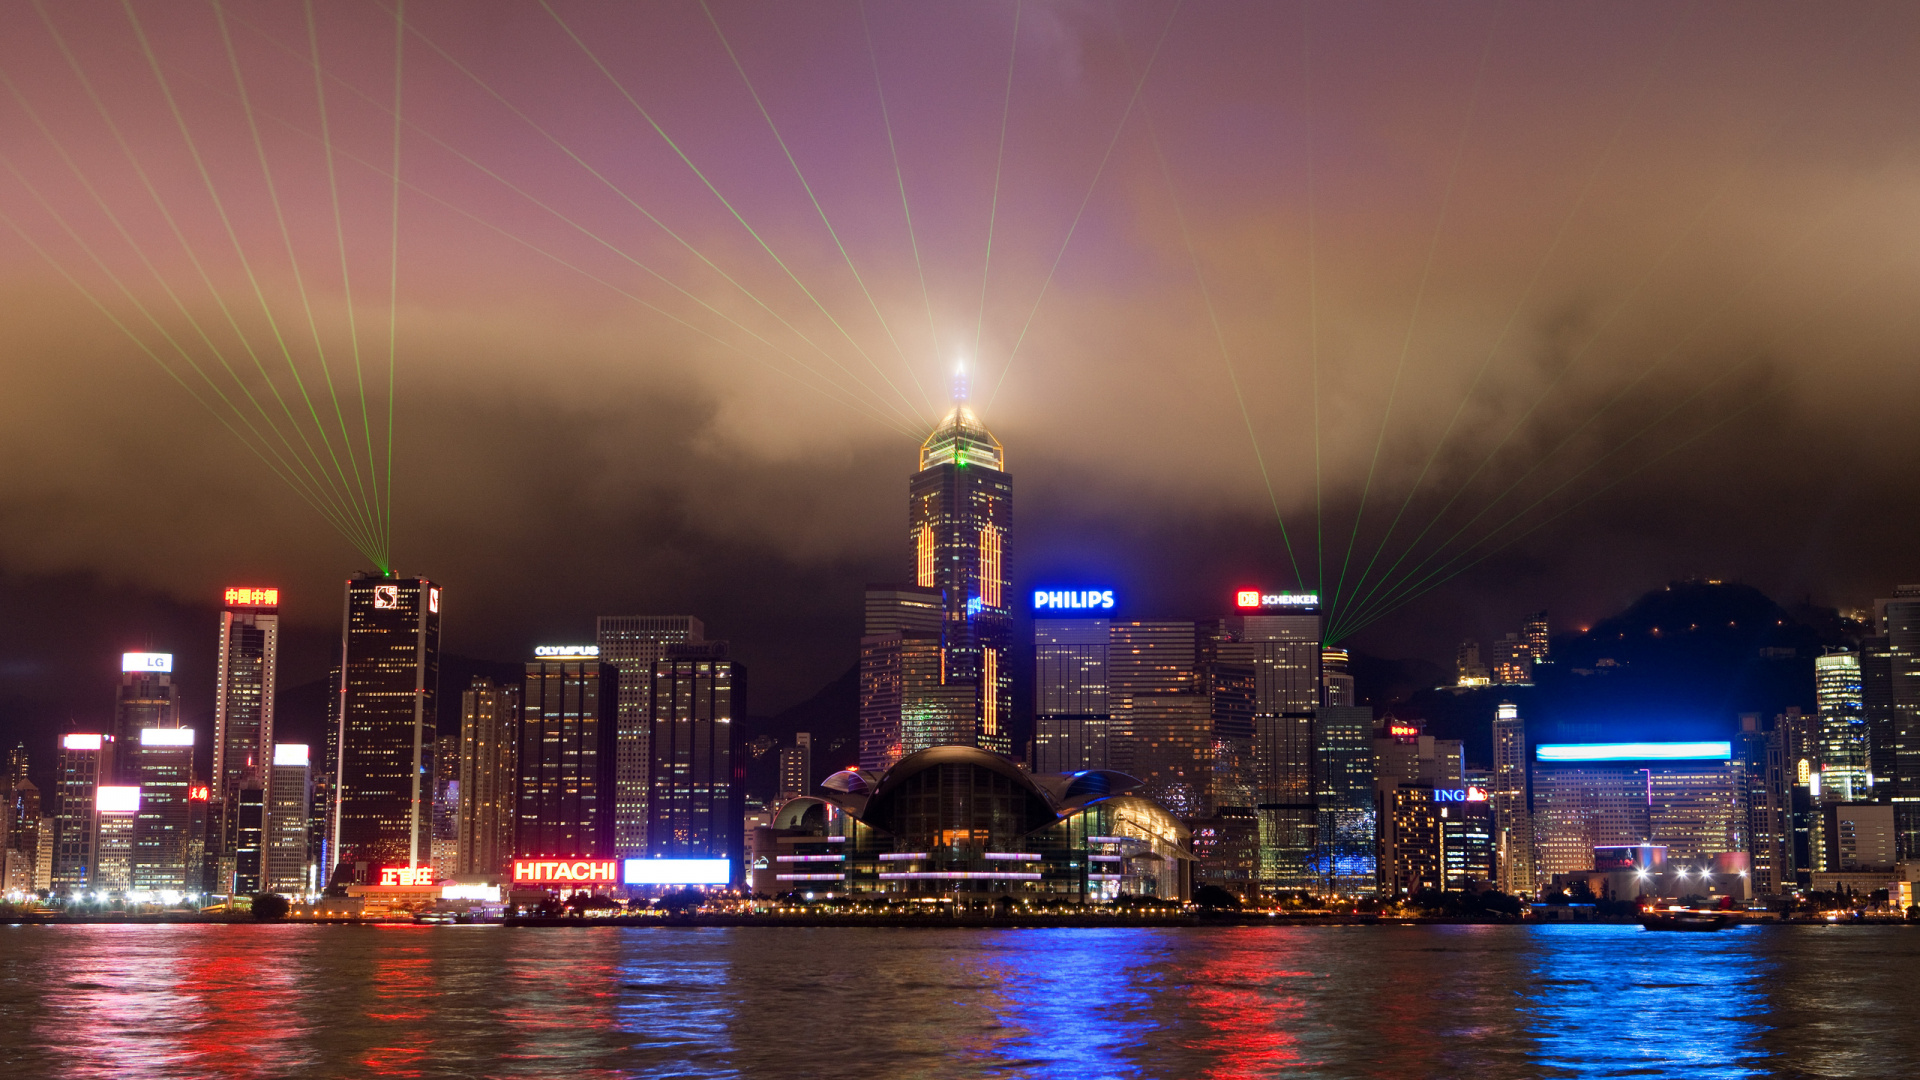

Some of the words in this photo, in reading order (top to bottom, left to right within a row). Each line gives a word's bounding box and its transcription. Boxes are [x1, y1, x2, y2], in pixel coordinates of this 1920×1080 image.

[1034, 590, 1114, 608] PHILIPS
[1240, 593, 1257, 605] DB
[1261, 595, 1318, 605] SCHENKER
[534, 645, 600, 656] OLYMPUS
[668, 644, 710, 654] Allianz
[147, 657, 164, 667] LG
[1433, 789, 1465, 802] ING
[380, 867, 434, 886] 正官庄
[515, 862, 616, 880] HITACHI
